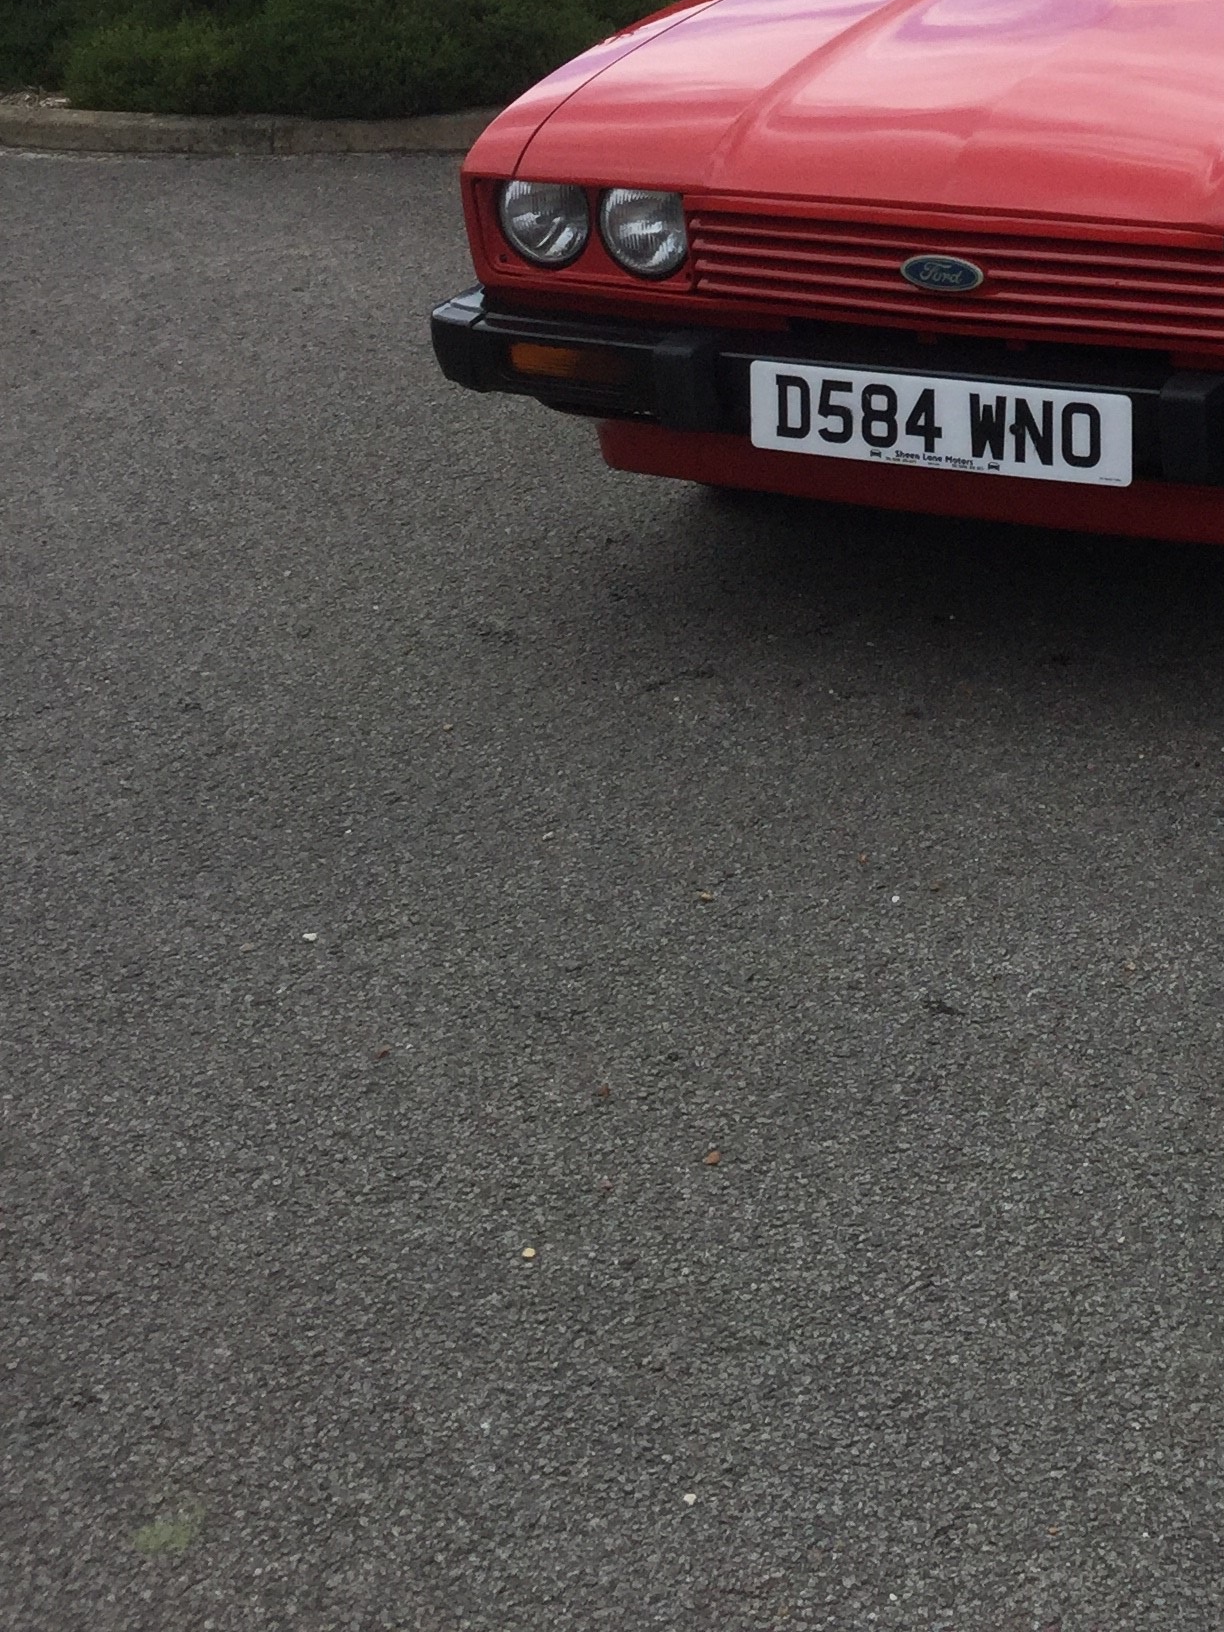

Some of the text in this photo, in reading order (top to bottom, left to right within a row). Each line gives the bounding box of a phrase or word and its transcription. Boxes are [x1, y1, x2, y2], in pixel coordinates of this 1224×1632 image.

[919, 261, 963, 284] Ford
[775, 374, 1101, 468] D584 WNO
[895, 450, 920, 460] Sheen
[922, 453, 942, 462] Lane
[944, 456, 973, 466] Motors
